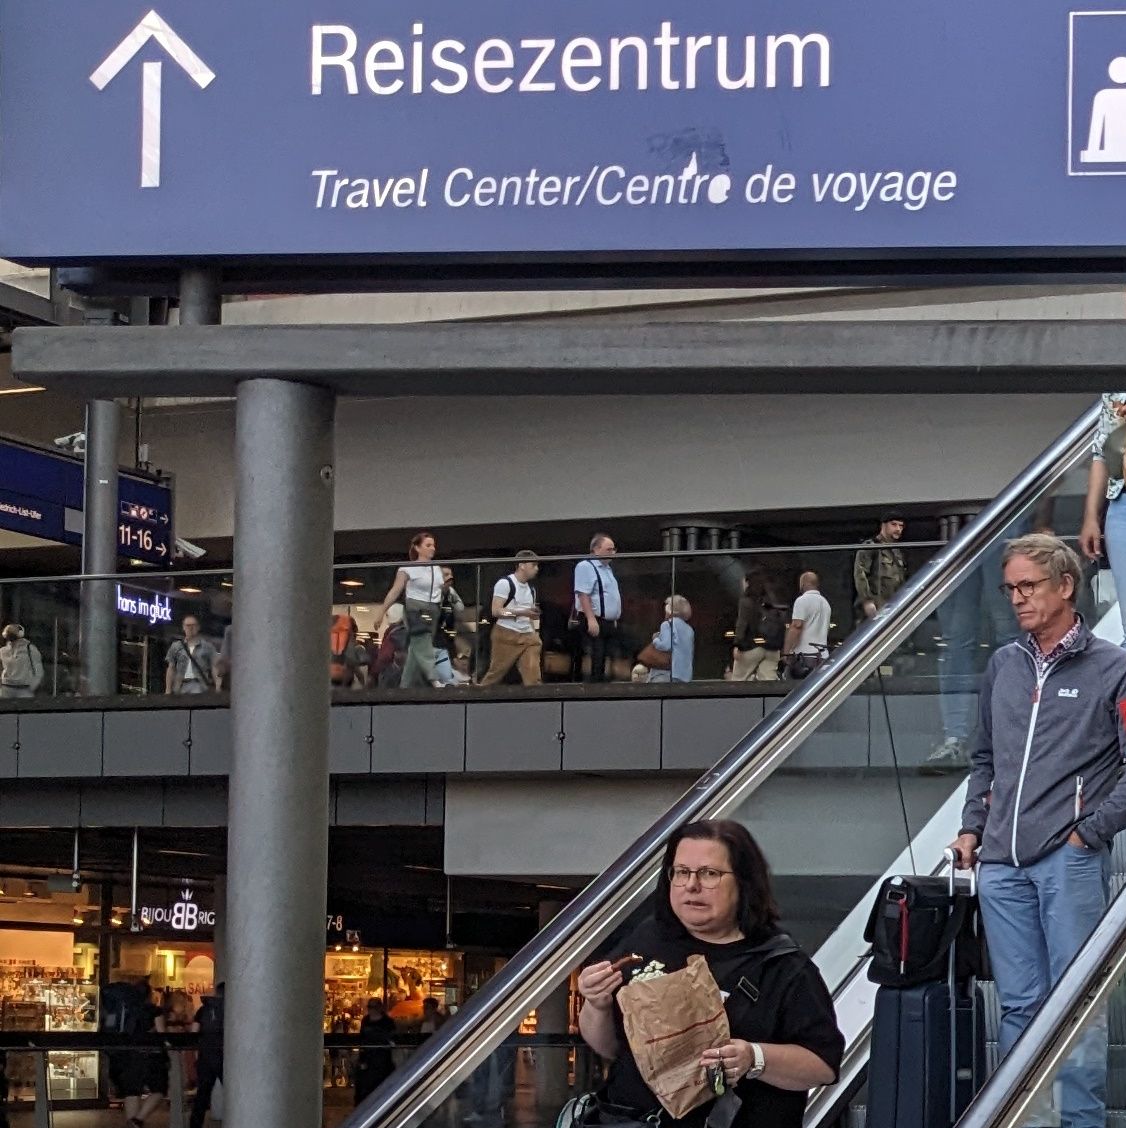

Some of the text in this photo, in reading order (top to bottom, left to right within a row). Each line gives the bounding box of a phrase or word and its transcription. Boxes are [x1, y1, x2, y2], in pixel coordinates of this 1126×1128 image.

[309, 21, 831, 96] Reisezentrum
[311, 169, 428, 209] Travel
[744, 165, 796, 203] de
[812, 170, 957, 211] voyage
[119, 524, 153, 551] 11-16
[116, 584, 172, 624] hans im glück
[140, 906, 172, 925] BIJOU
[327, 915, 343, 931] 7-8
